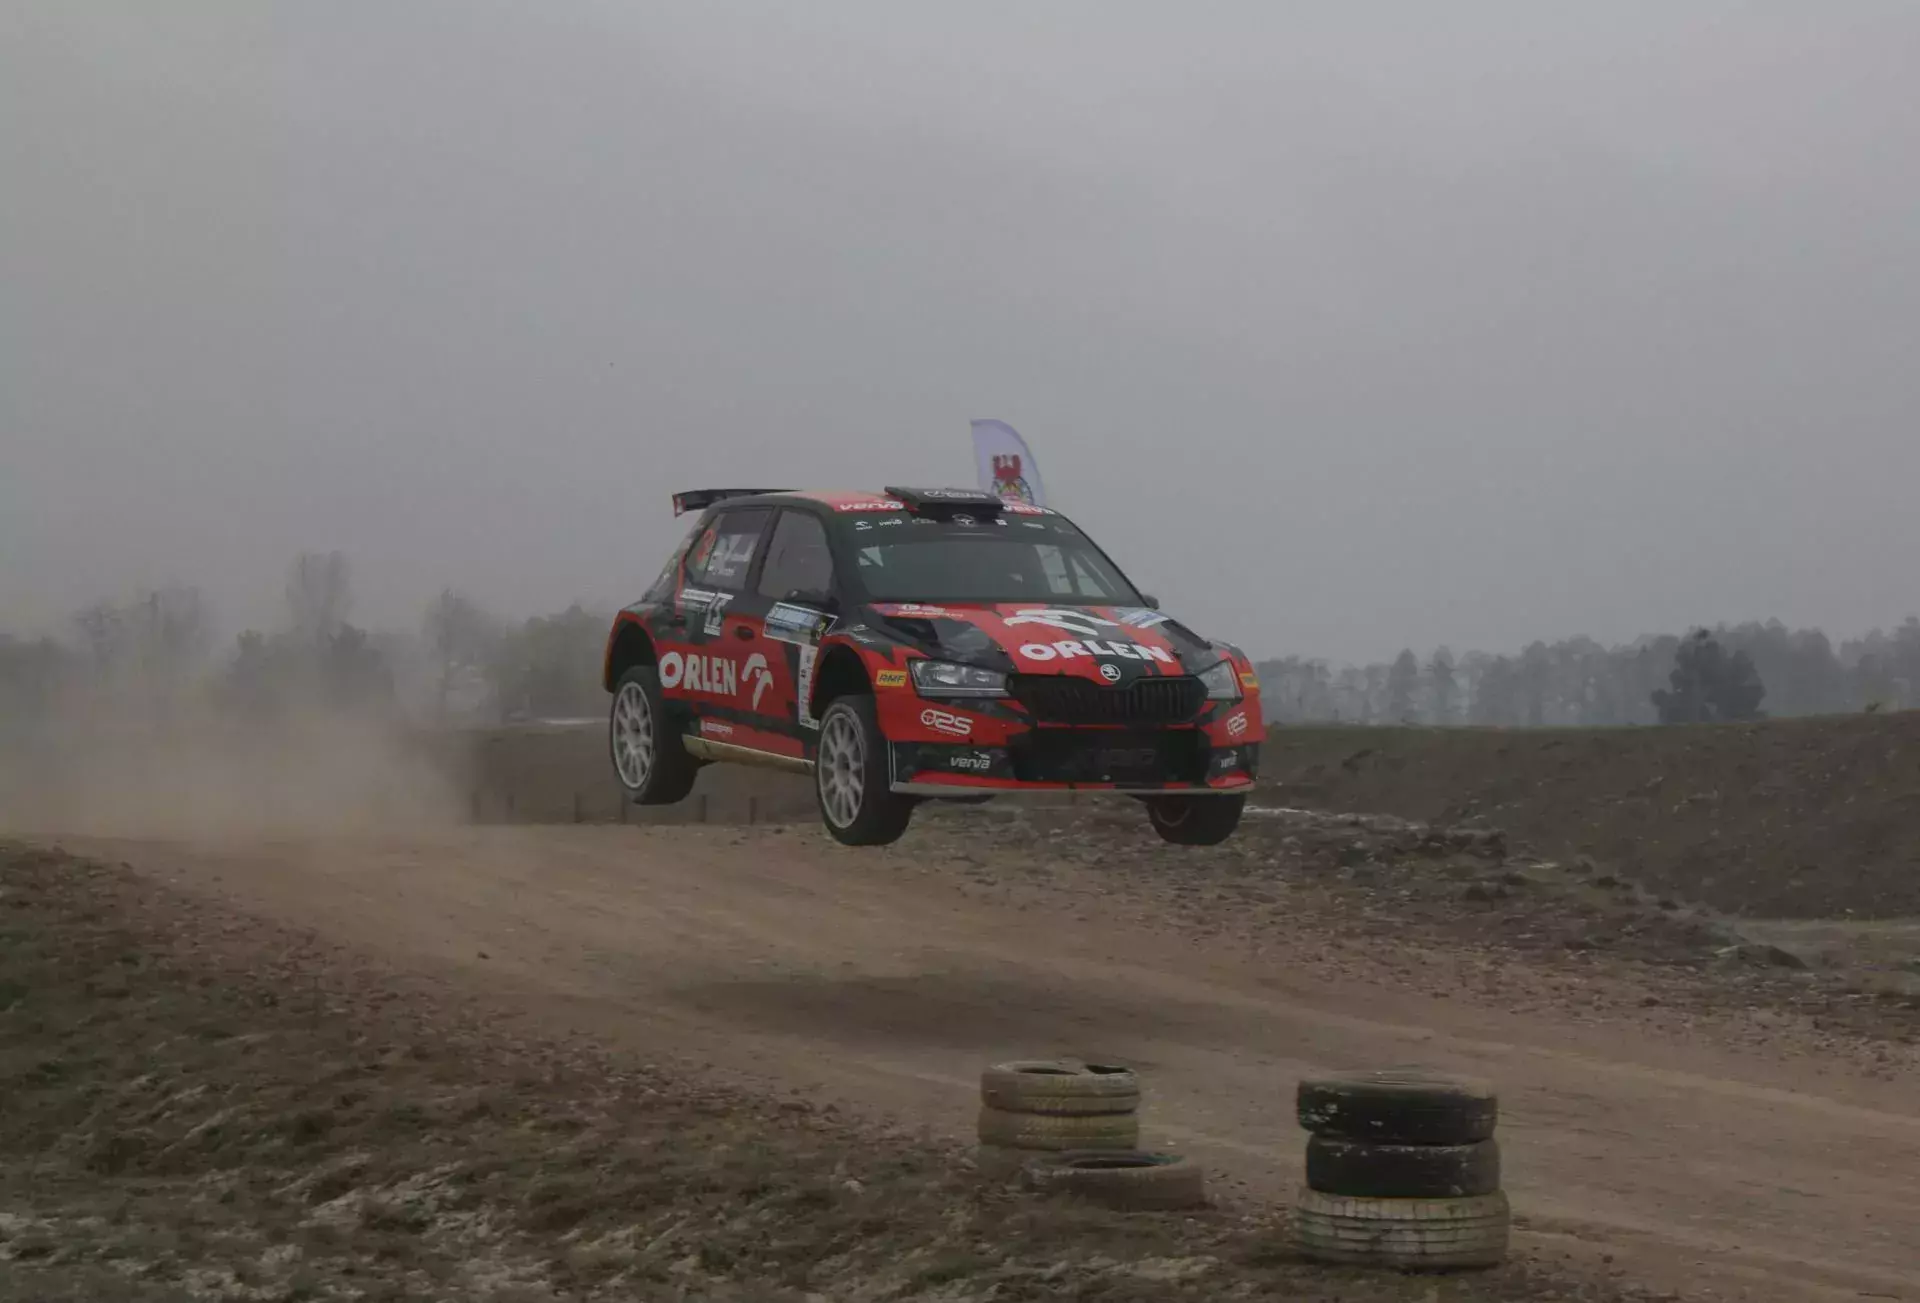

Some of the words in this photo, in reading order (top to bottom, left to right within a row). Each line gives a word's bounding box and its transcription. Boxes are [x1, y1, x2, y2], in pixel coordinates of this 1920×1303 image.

[839, 501, 904, 511] verva
[1018, 639, 1176, 663] ORLEN
[658, 651, 737, 697] ORLEN
[879, 673, 906, 684] RMF
[950, 756, 991, 769] verva
